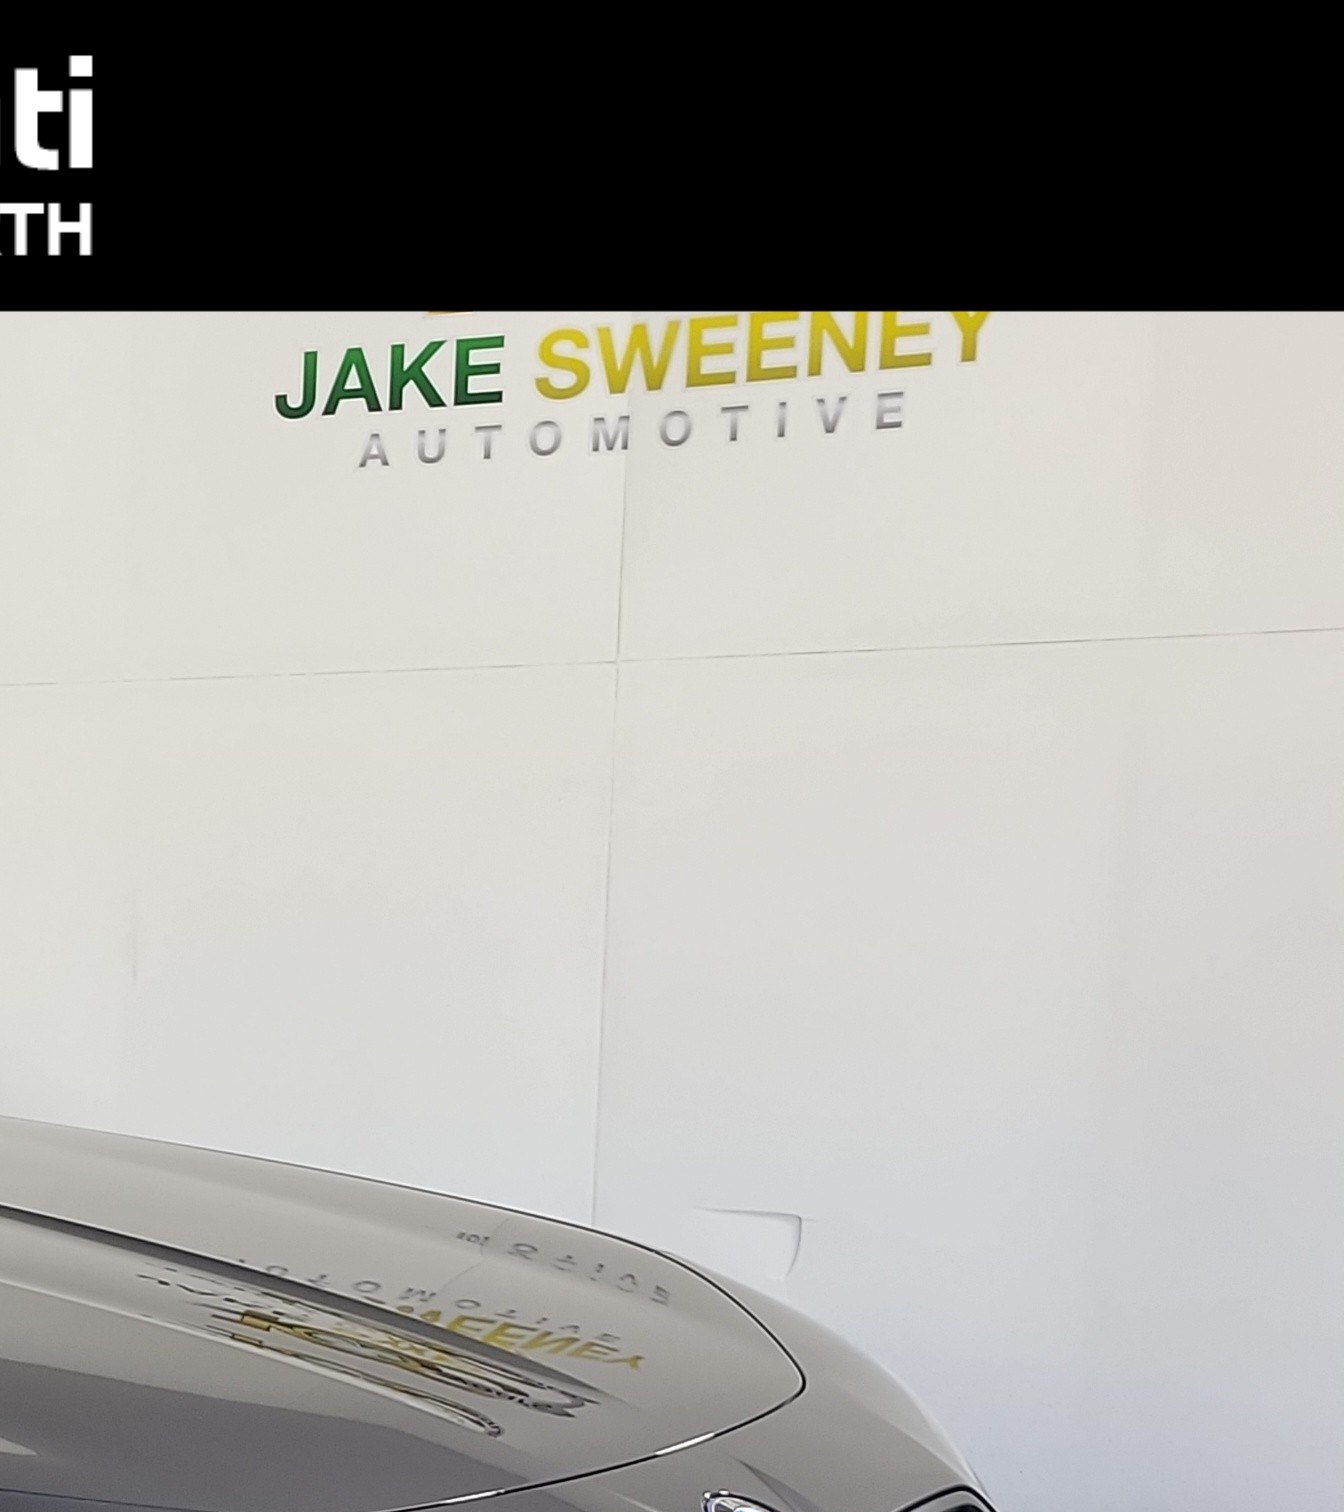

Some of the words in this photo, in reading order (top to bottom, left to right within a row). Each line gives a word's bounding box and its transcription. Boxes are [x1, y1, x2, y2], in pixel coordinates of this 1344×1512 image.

[274, 336, 505, 419] JAKE
[535, 311, 993, 400] SWEENEY
[358, 391, 905, 468] AUTOMOTIVE
